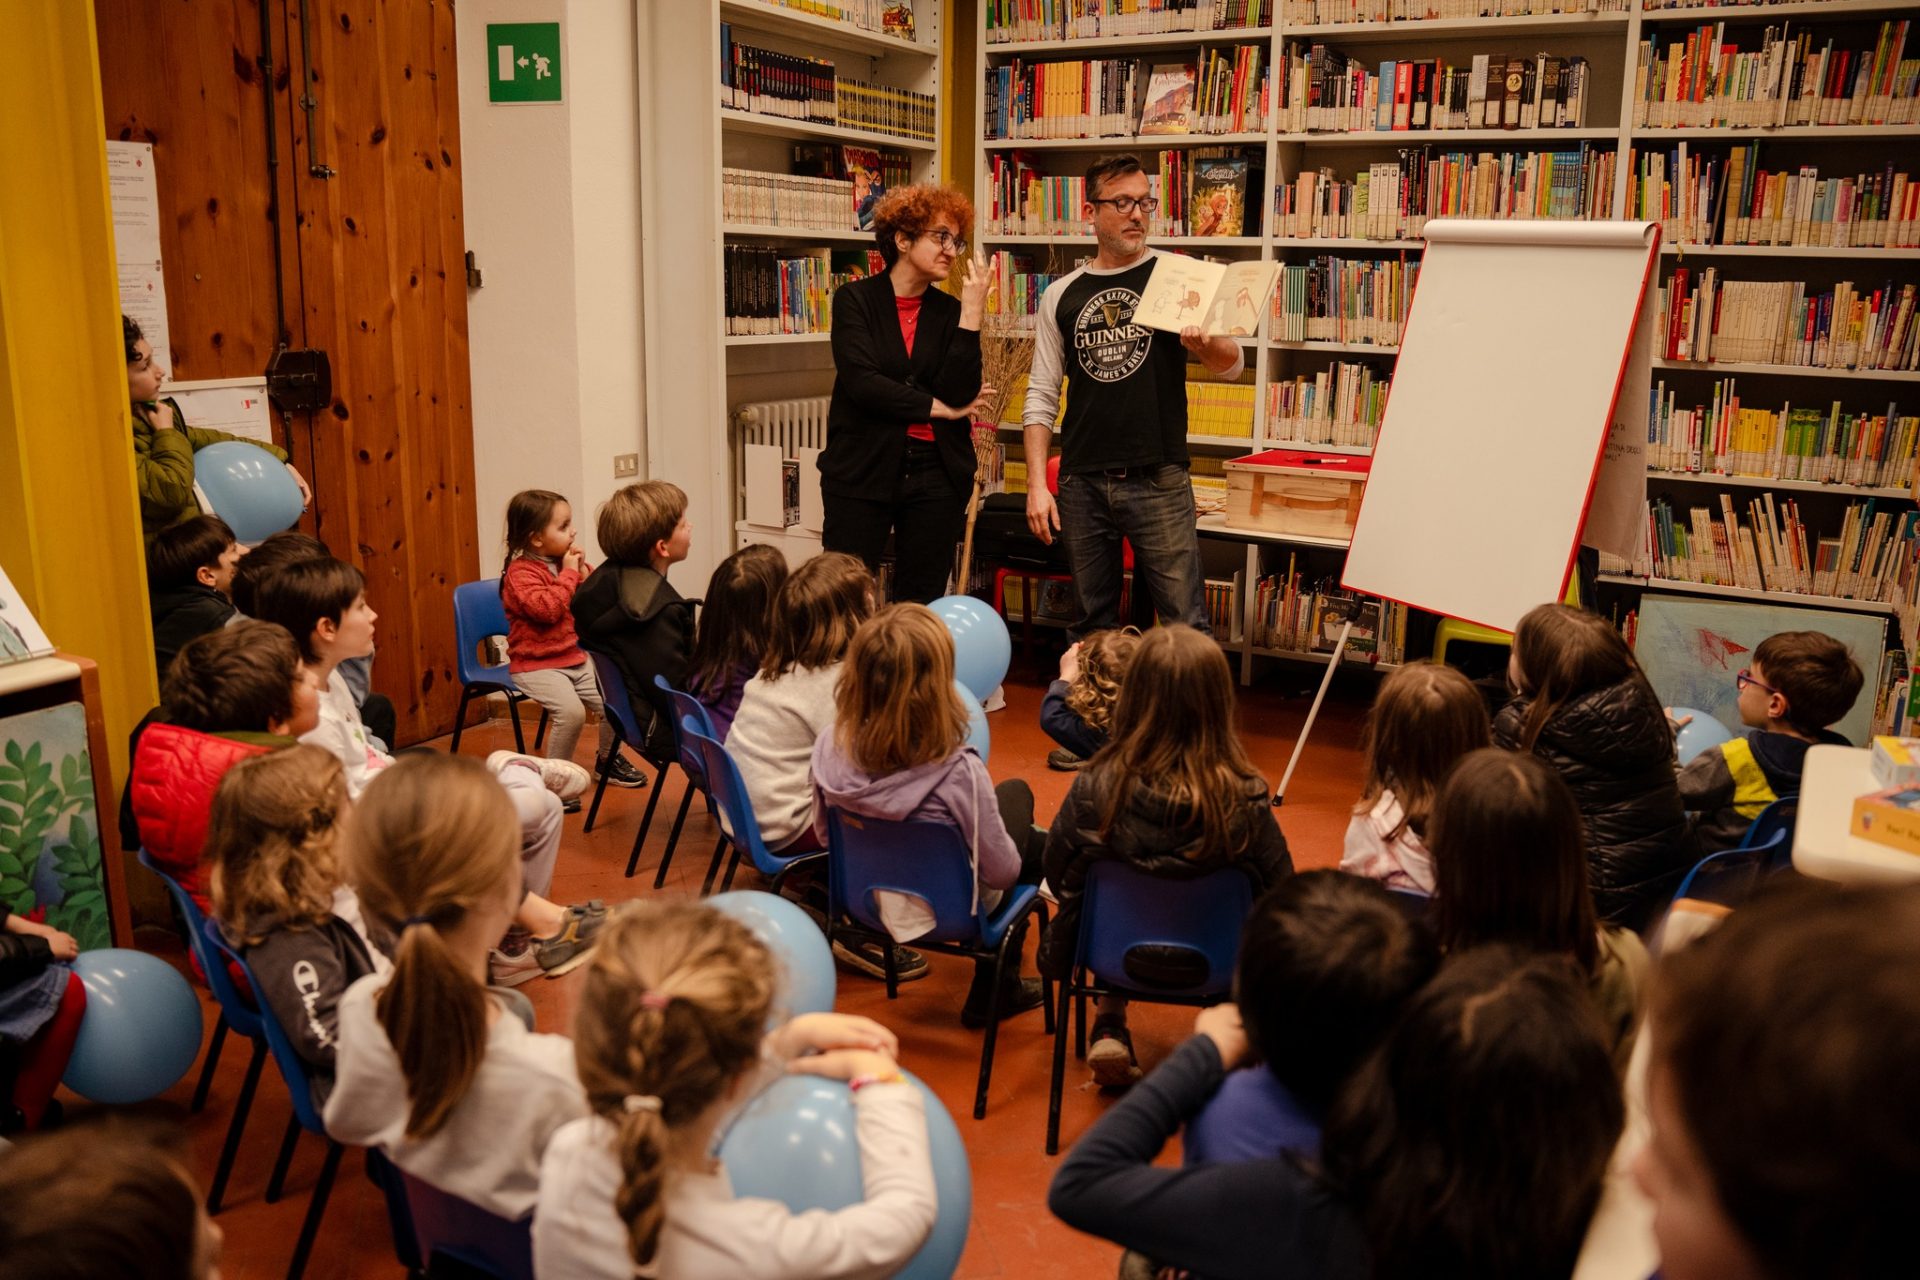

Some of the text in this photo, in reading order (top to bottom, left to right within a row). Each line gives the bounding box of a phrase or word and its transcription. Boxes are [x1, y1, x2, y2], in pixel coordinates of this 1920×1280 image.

[1106, 291, 1130, 303] EXTRA
[1074, 325, 1154, 349] GUINNESS
[1097, 345, 1127, 357] DUBLIN
[1094, 367, 1128, 379] JAMES'S
[1127, 350, 1143, 369] GATE
